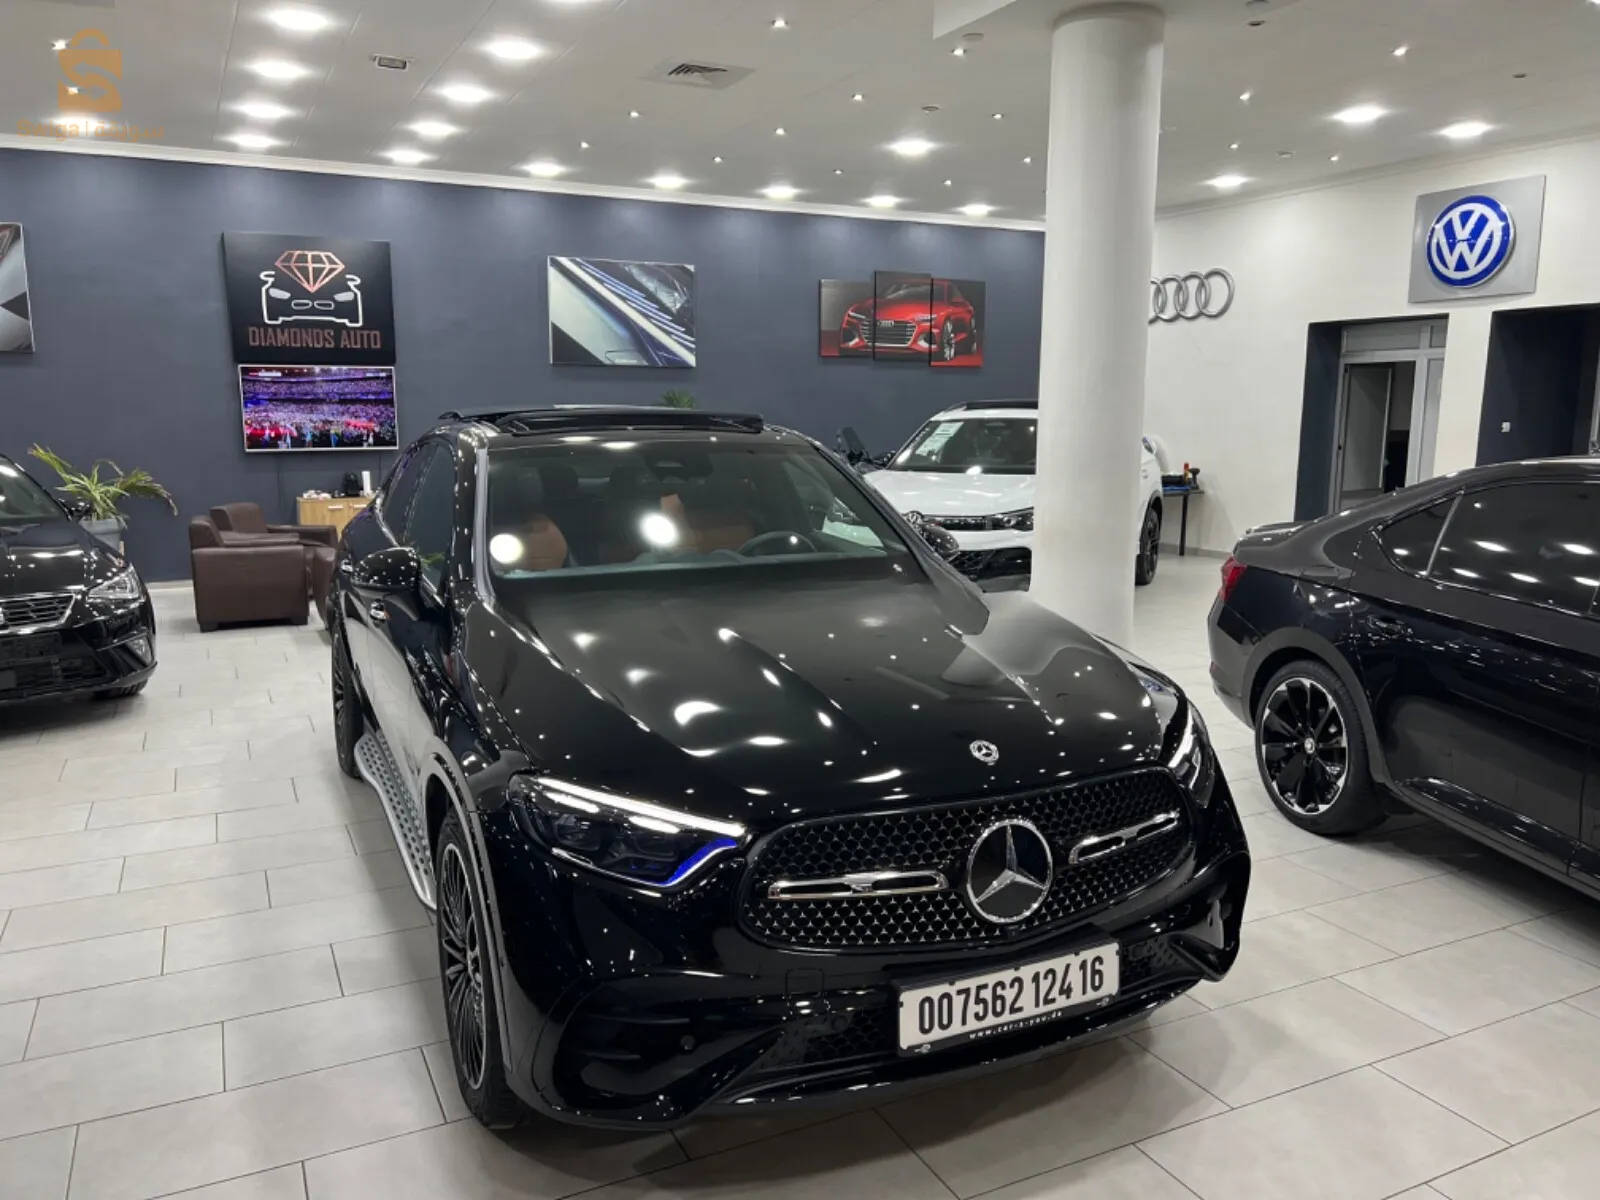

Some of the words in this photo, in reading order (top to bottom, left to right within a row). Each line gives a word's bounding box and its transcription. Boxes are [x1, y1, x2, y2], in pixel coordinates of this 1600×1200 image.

[248, 326, 335, 349] DIAMONDS
[340, 329, 382, 350] AUTO
[918, 976, 1025, 1035] 007562
